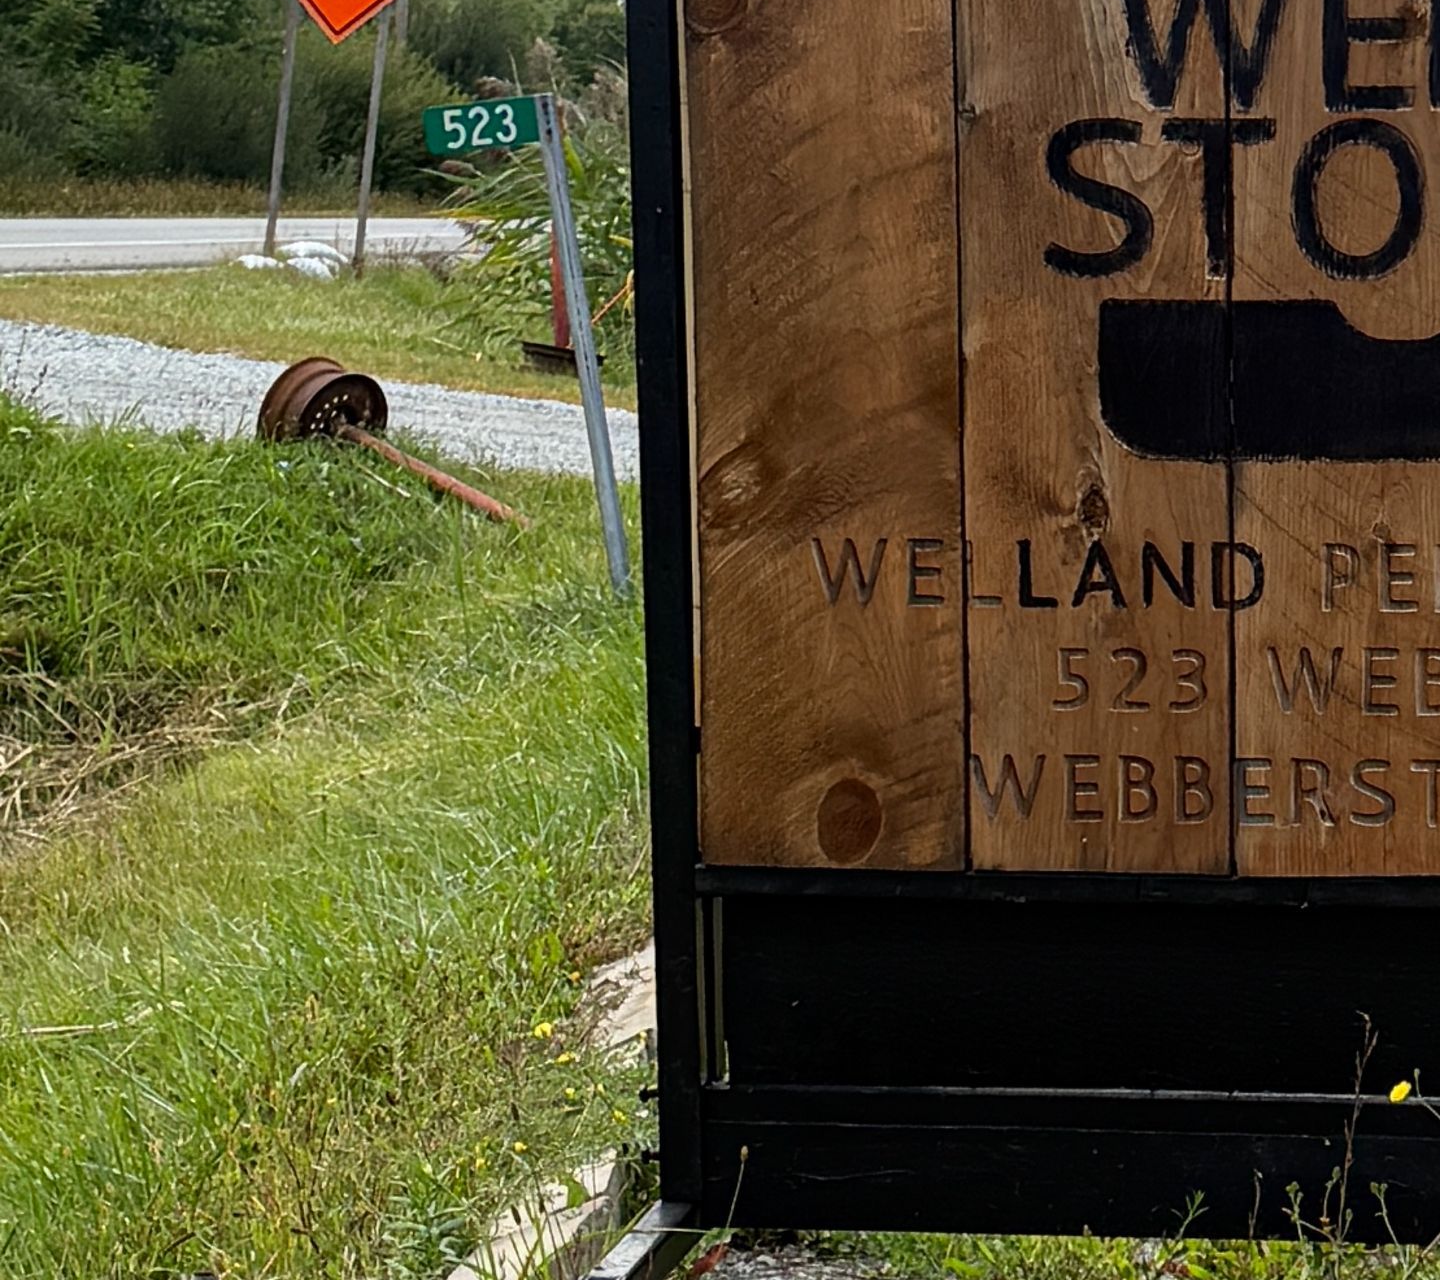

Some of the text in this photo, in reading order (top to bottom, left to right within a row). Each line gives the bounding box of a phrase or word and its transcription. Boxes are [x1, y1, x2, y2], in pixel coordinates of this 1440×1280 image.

[443, 103, 518, 150] 523
[811, 537, 1266, 612] WELLAND
[1052, 647, 1209, 715] 523
